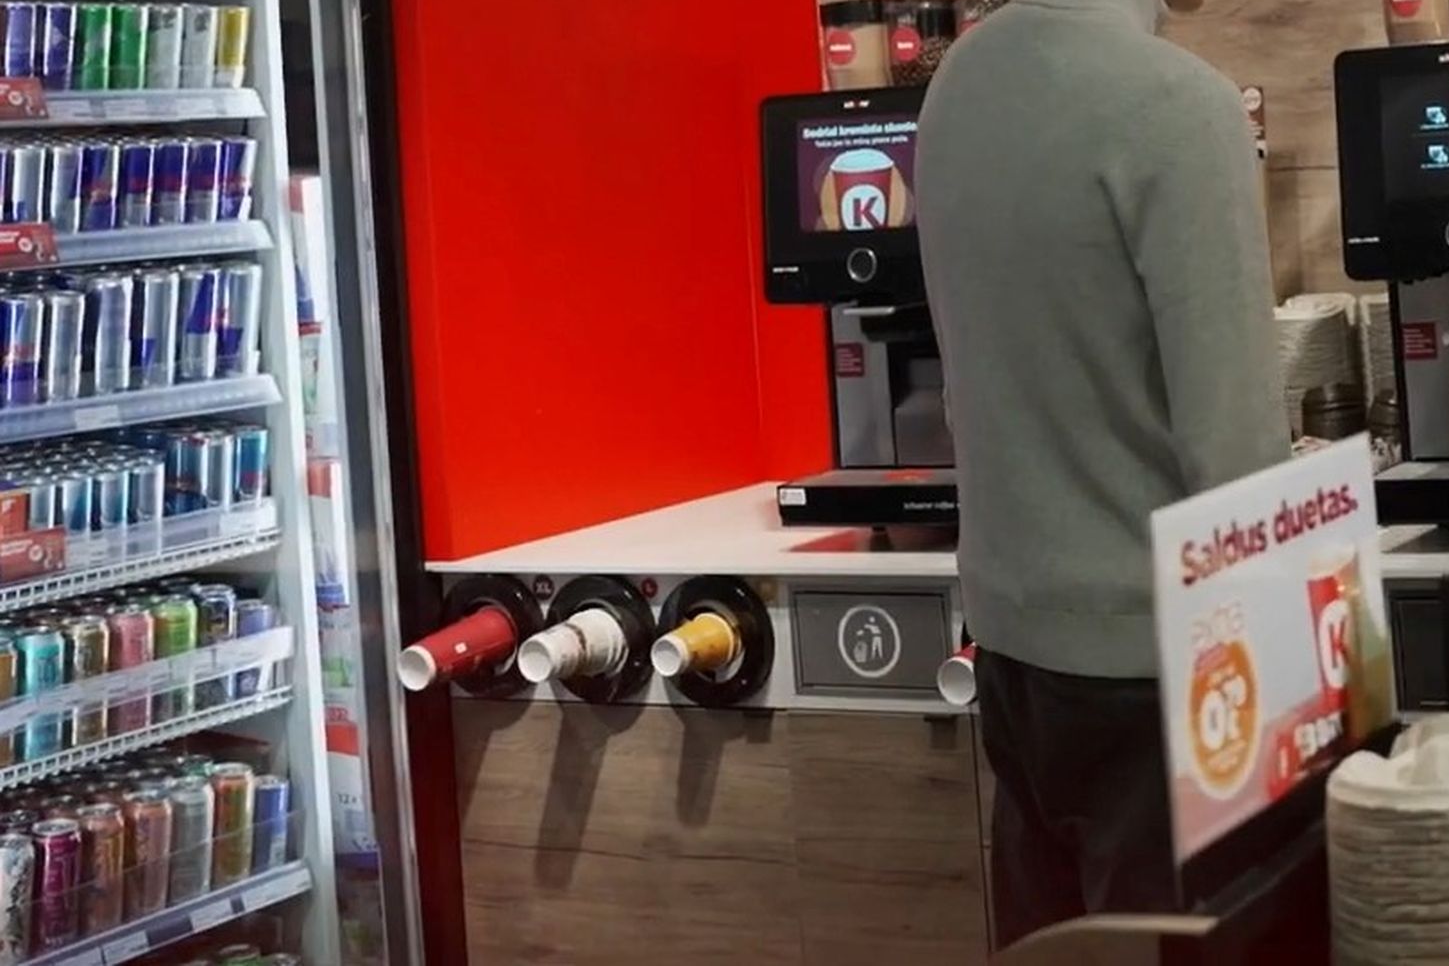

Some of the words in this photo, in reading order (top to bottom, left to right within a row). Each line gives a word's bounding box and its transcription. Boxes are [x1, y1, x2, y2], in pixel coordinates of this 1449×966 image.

[853, 197, 882, 228] K
[1272, 483, 1360, 547] duetas.
[1180, 518, 1269, 588] Saldus
[535, 580, 552, 595] XL
